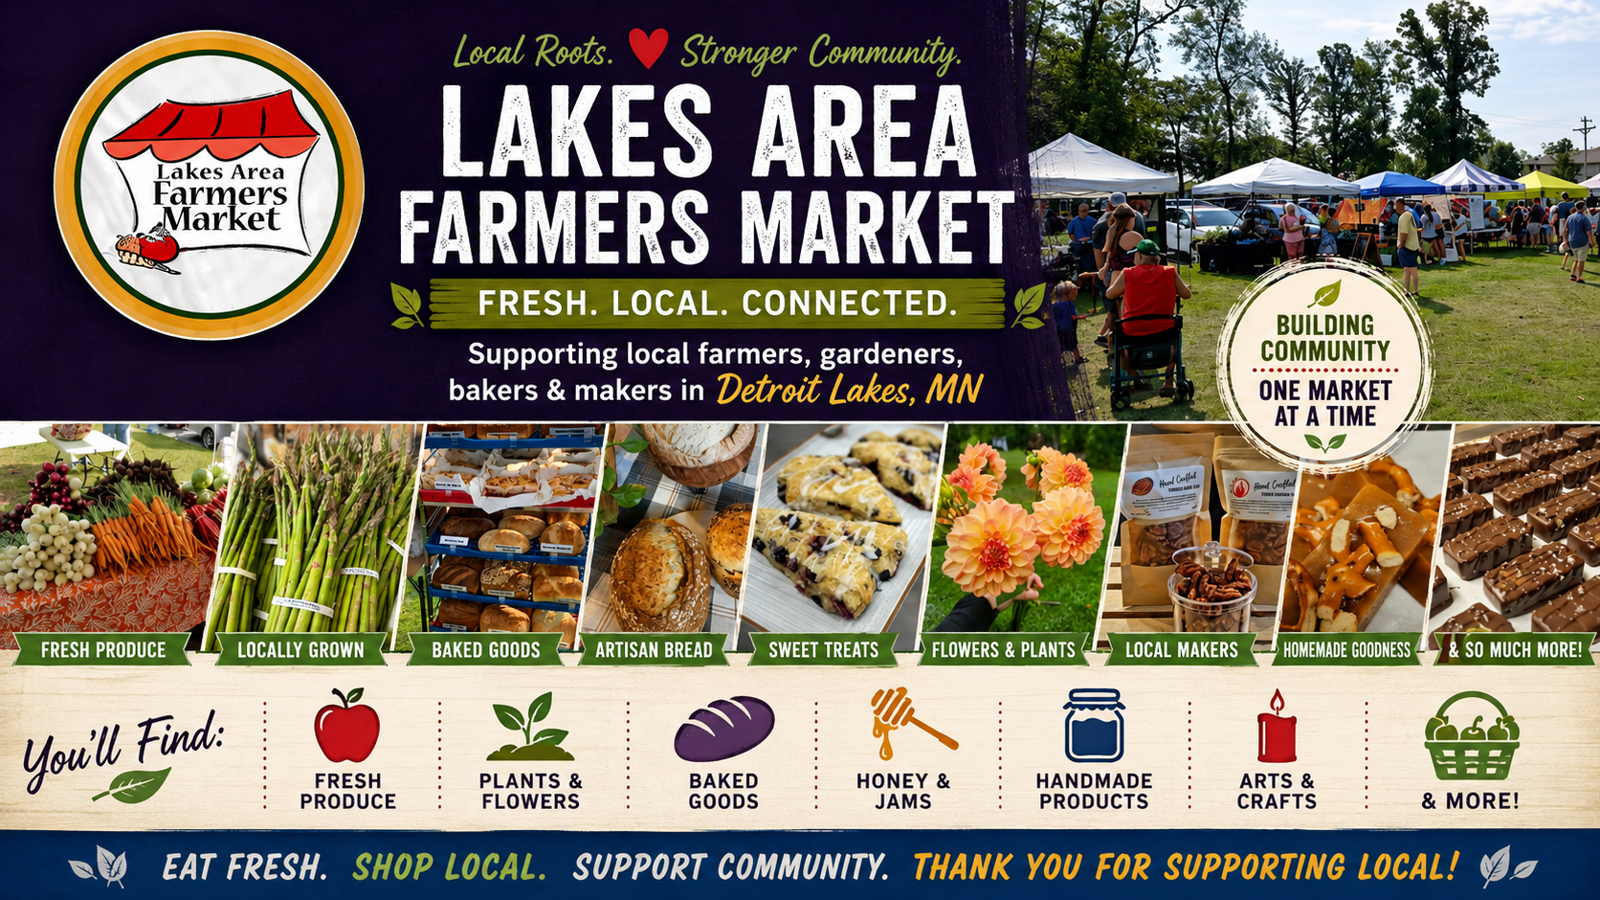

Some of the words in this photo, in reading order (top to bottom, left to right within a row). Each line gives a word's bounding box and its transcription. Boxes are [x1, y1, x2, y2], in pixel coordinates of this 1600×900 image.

[453, 33, 526, 68] Local
[534, 33, 613, 68] Roots.
[680, 33, 798, 78] Stronger
[809, 33, 962, 78] Community.
[442, 83, 713, 179] LAKES
[751, 84, 977, 178] AREA
[157, 161, 223, 180] Lakes
[230, 163, 284, 180] Area
[153, 180, 288, 206] Farmers
[162, 205, 282, 231] Market
[400, 189, 710, 266] FARMERS
[741, 190, 1016, 265] MARKET
[479, 289, 597, 316] FRESH.
[612, 289, 728, 316] LOCAL.
[742, 289, 957, 316] CONNECTED.
[1277, 313, 1374, 336] BUILDING
[468, 341, 618, 371] Supporting
[627, 341, 690, 365] local
[697, 341, 811, 369] farmers,
[819, 341, 963, 371] gardeners,
[1261, 339, 1391, 362] COMMUNITY
[449, 377, 539, 401] bakers
[546, 378, 566, 401] &
[575, 377, 672, 401] makers
[681, 377, 704, 401] in
[716, 372, 823, 405] Detroit
[828, 372, 916, 407] Lakes,
[925, 372, 985, 405] MN
[1259, 379, 1301, 401] ONE
[1308, 379, 1393, 401] MARKET
[1274, 405, 1299, 427] AT
[1305, 405, 1320, 427] A
[1326, 405, 1377, 427] TIME
[41, 641, 90, 659] FRESH
[96, 641, 166, 659] PRODUCE
[237, 641, 303, 659] LOCALLY
[308, 641, 364, 659] GROWN
[432, 641, 483, 658] BAKED
[488, 641, 541, 659] GOODS
[595, 641, 659, 658] ARTISAN
[664, 641, 713, 658] BREAD
[768, 641, 819, 659] SWEET
[823, 641, 879, 658] TREATS
[932, 641, 1000, 658] FLOWERS
[1004, 641, 1015, 658] &
[1021, 641, 1076, 658] PLANTS
[1125, 641, 1172, 658] LOCAL
[1177, 641, 1239, 658] MAKERS
[1283, 641, 1348, 658] HOMEMADE
[1351, 641, 1411, 658] GOODNESS
[1449, 641, 1460, 658] &
[1465, 641, 1484, 658] SO
[1490, 641, 1532, 658] MUCH
[1537, 641, 1583, 658] MORE!
[23, 724, 121, 795] You'll
[137, 709, 225, 763] Find:
[315, 772, 381, 789] FRESH
[479, 772, 561, 789] PLANTS
[568, 772, 583, 789] &
[689, 772, 759, 789] BAKED
[857, 772, 929, 789] HONEY
[936, 772, 951, 789] &
[1036, 772, 1153, 789] HANDMADE
[1239, 772, 1293, 789] ARTS
[1300, 772, 1315, 789] &
[300, 793, 397, 810] PRODUCE
[482, 793, 580, 810] FLOWERS
[688, 793, 759, 810] GOODS
[874, 793, 932, 810] JAMS
[1040, 793, 1149, 810] PRODUCTS
[1237, 793, 1317, 810] CRAFTS
[1421, 792, 1437, 810] &
[1446, 791, 1519, 810] MORE!
[162, 852, 218, 881] EAT
[226, 852, 327, 881] FRESH.
[352, 852, 434, 881] SHOP
[444, 852, 546, 881] LOCAL.
[572, 852, 709, 881] SUPPORT
[717, 852, 888, 881] COMMUNITY.
[914, 852, 1014, 881] THANK
[1027, 852, 1083, 881] YOU
[1095, 852, 1152, 881] FOR
[1163, 852, 1346, 881] SUPPORTING
[1357, 850, 1460, 881] LOCAL!
